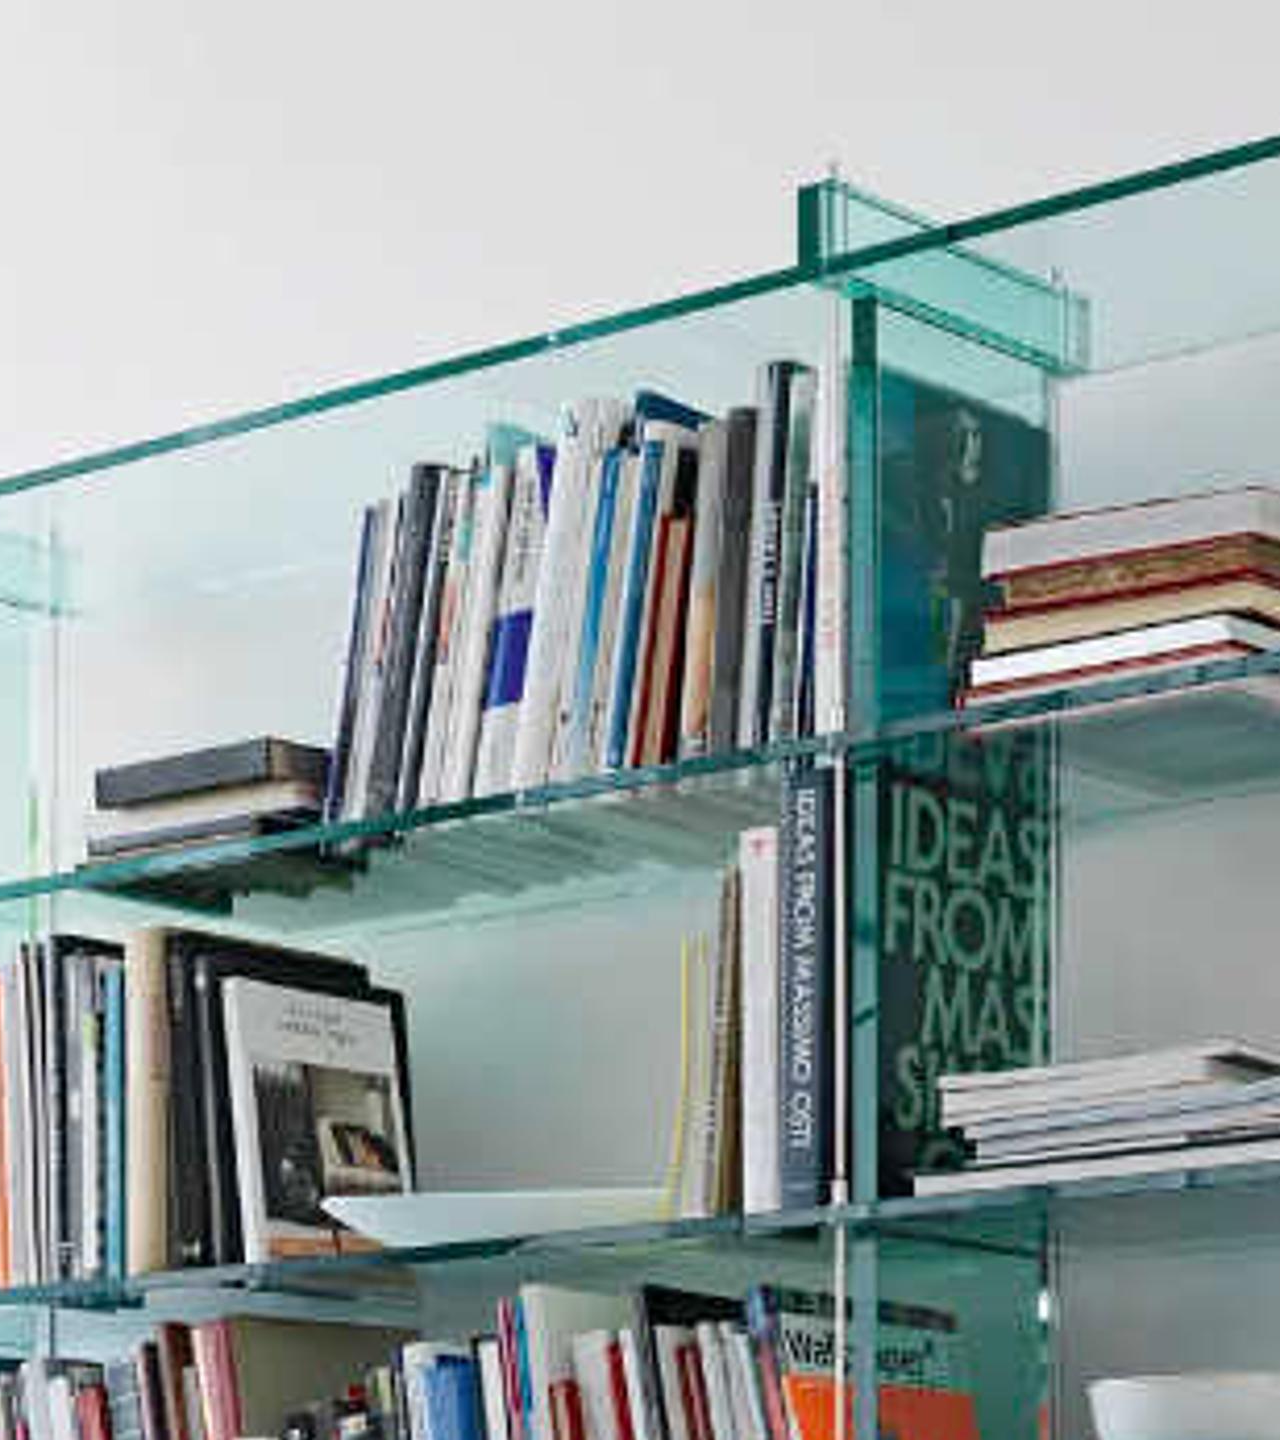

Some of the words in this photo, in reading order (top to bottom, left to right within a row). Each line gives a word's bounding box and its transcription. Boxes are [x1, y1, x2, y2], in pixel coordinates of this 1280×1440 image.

[795, 787, 817, 866] IDEAS
[892, 783, 1044, 898] IDEAS
[793, 871, 816, 949] FROM
[885, 869, 1042, 978] FROM
[791, 953, 814, 1082] MASSIMO
[922, 963, 1044, 1067] MAS
